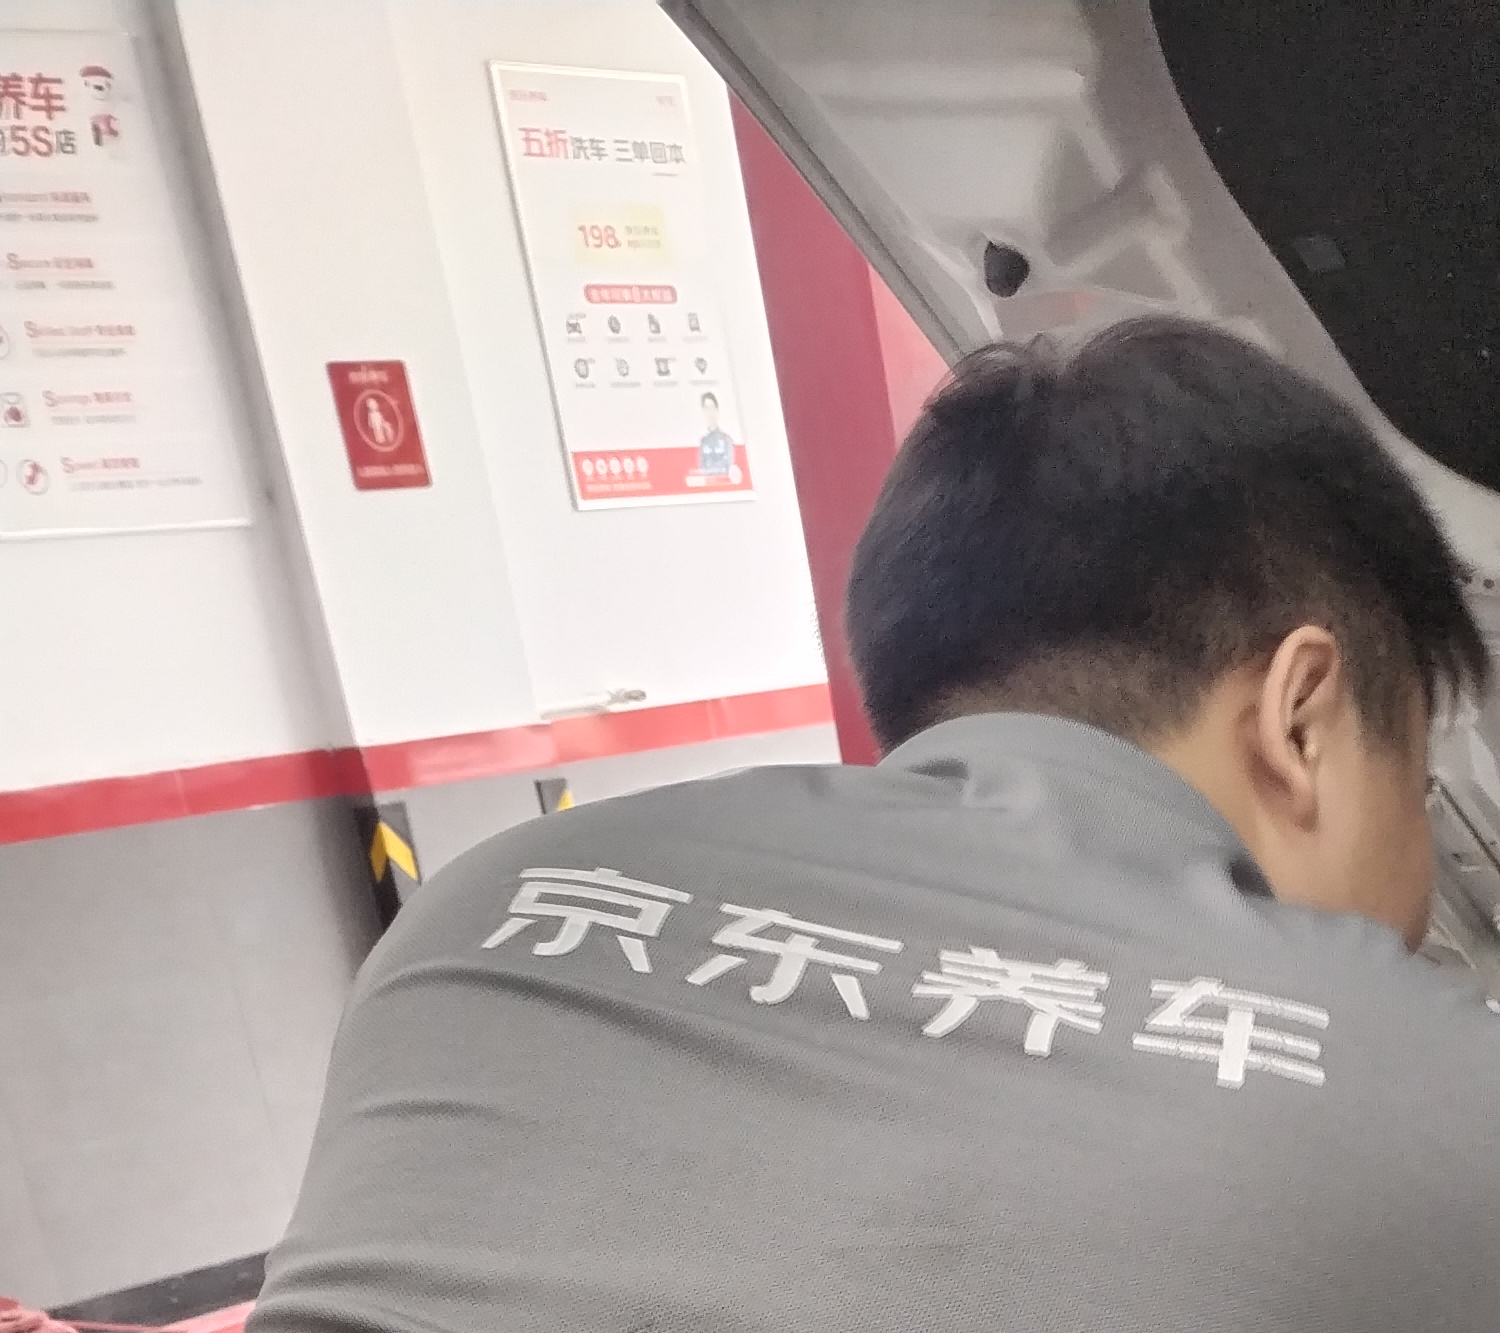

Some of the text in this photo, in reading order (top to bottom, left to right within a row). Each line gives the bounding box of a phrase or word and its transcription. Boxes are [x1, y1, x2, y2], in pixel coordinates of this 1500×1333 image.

[0, 125, 76, 157] 5S店
[517, 127, 608, 160] 五折洗车
[481, 866, 1330, 1088] 京东养车
